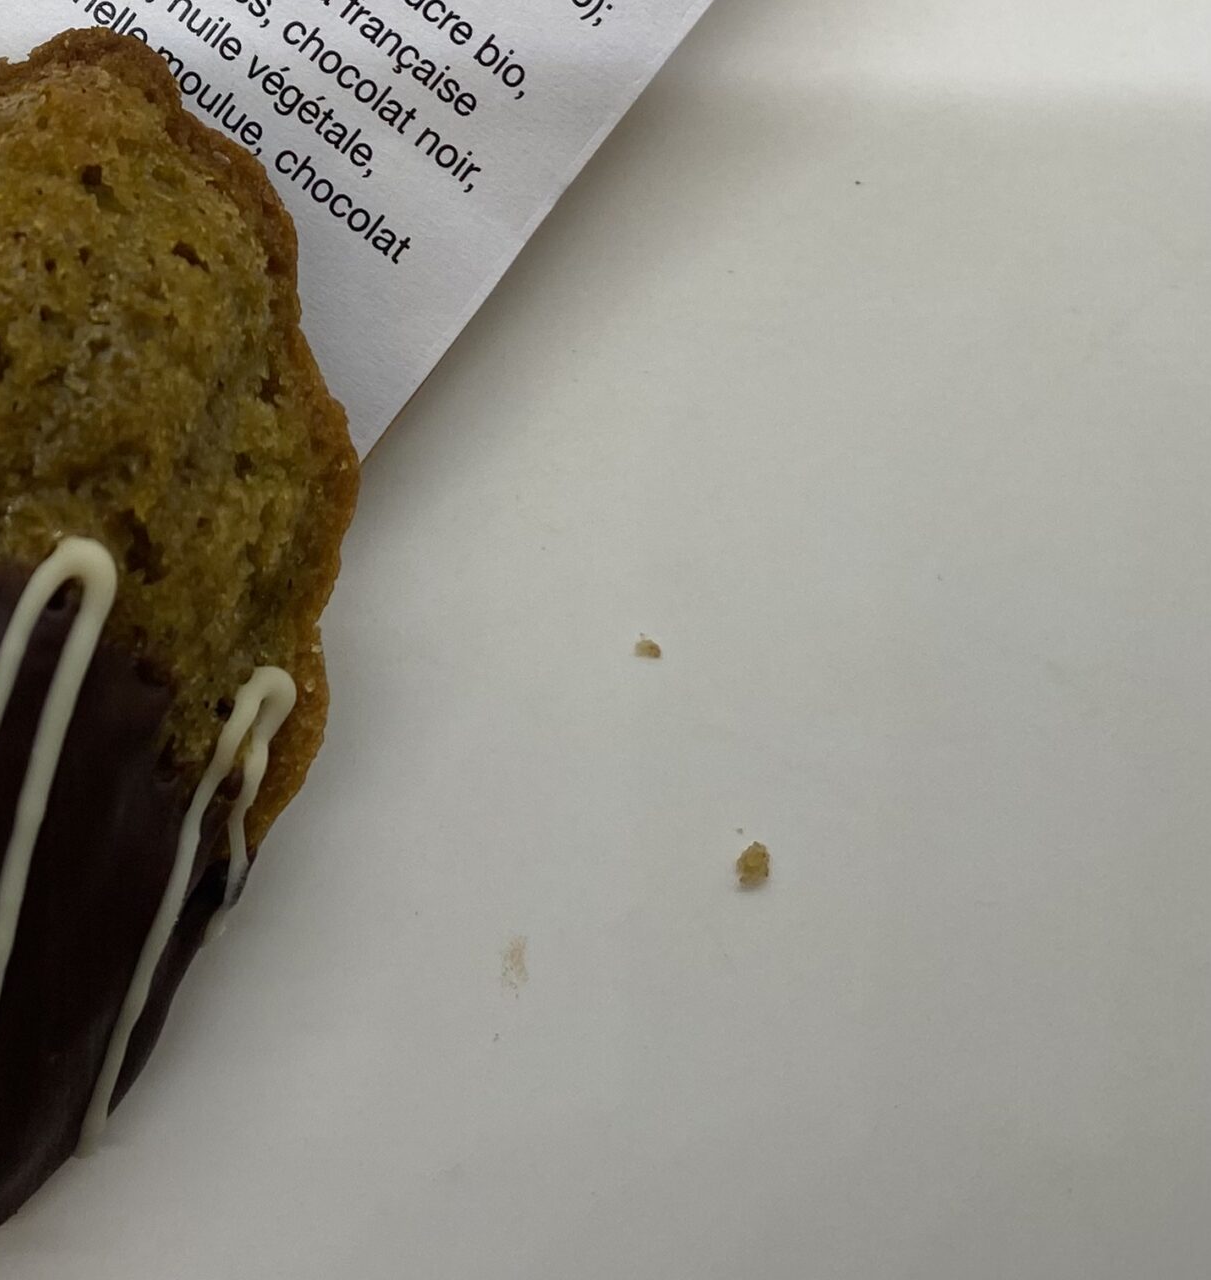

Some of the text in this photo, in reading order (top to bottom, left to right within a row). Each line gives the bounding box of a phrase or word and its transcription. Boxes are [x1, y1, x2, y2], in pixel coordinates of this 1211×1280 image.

[248, 55, 372, 178] végétale,
[283, 21, 417, 134] chocolat
[415, 128, 481, 193] noir,
[473, 34, 525, 100] bio,
[158, 47, 262, 155] moulue,
[276, 151, 410, 264] chocolat
